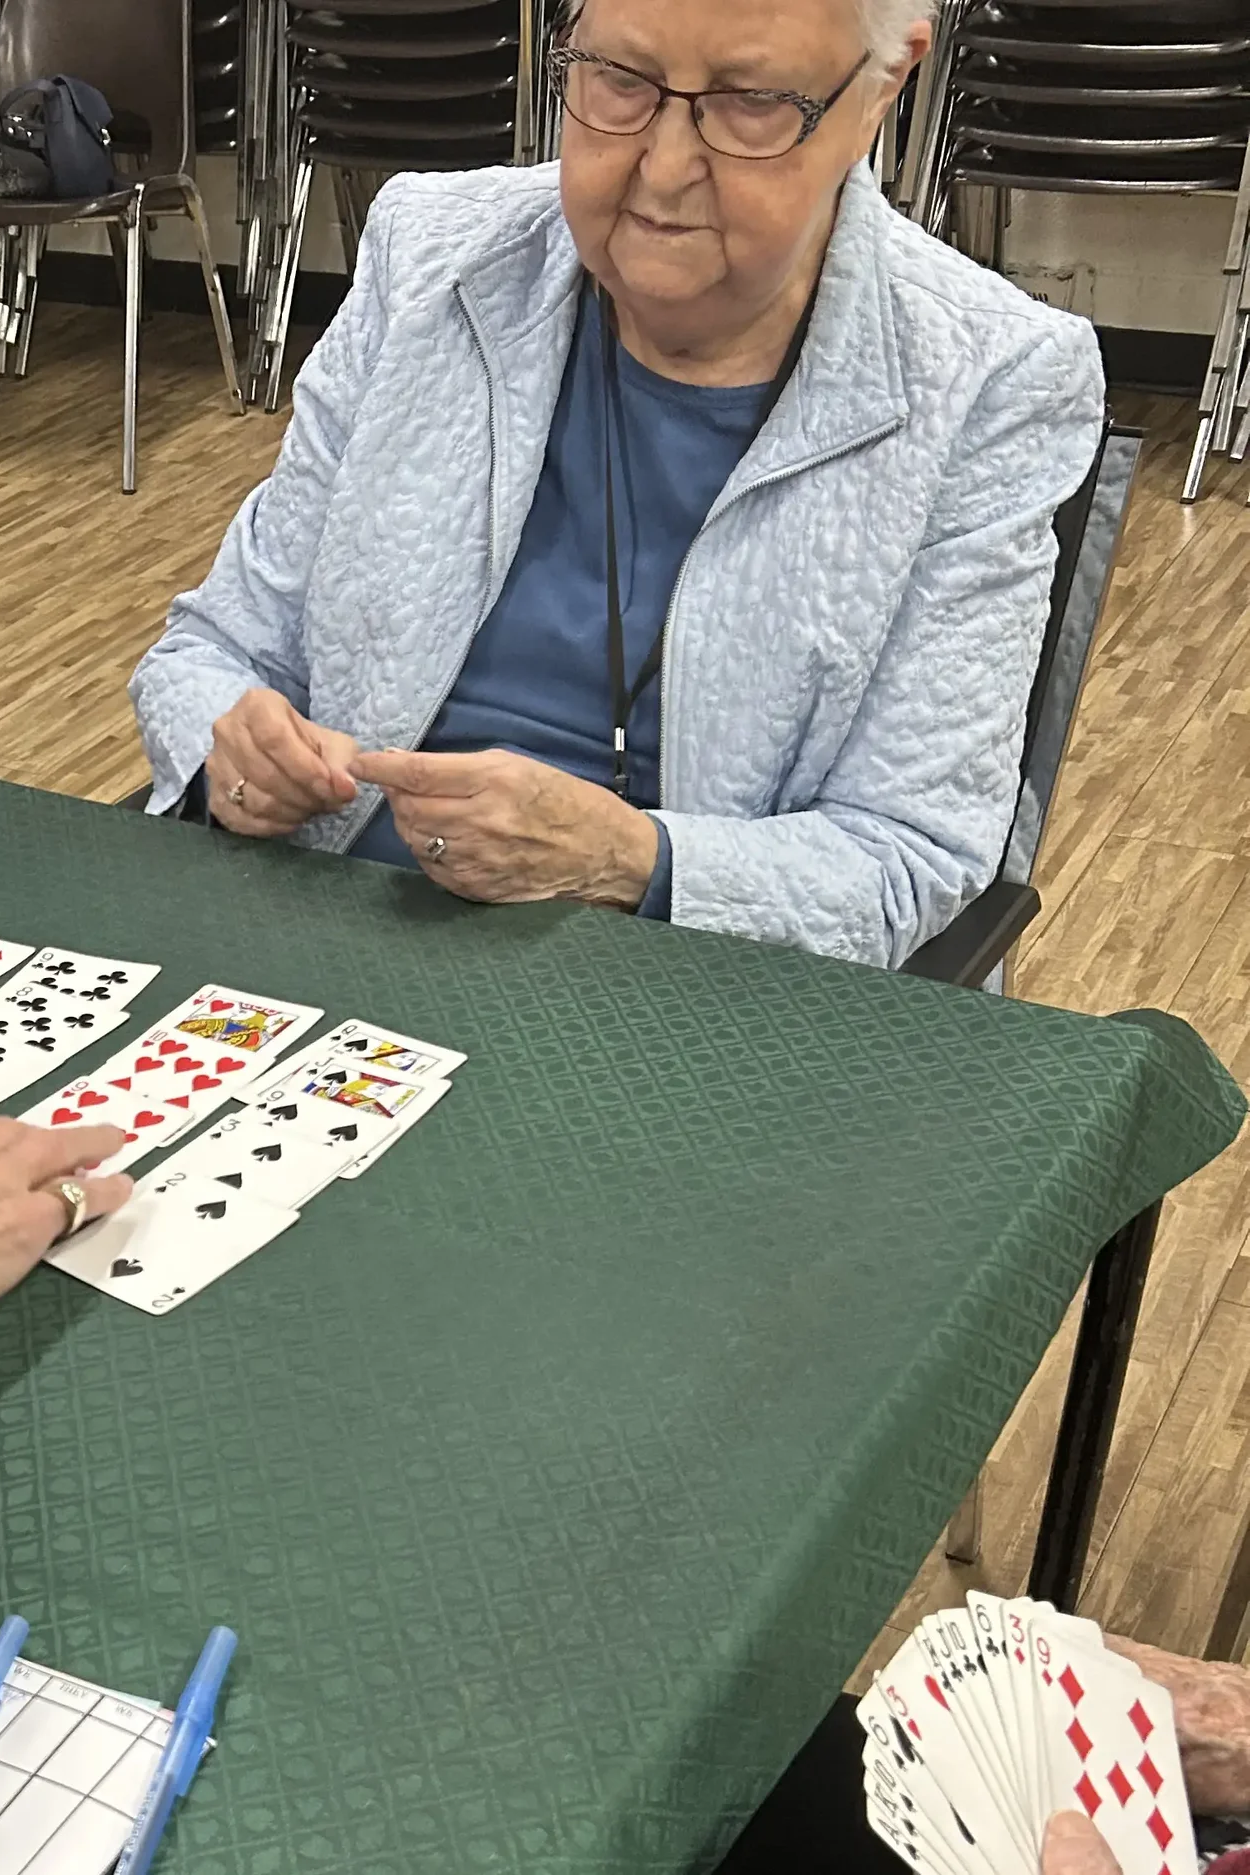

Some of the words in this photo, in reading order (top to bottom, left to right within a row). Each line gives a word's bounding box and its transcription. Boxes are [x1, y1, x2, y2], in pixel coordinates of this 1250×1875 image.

[16, 986, 33, 996] 8
[200, 990, 218, 1000] J
[149, 1030, 169, 1042] 10
[342, 1024, 358, 1035] Q
[314, 1057, 335, 1067] J
[266, 1090, 285, 1102] 9
[220, 1118, 241, 1132] 3
[165, 1172, 187, 1187] 2
[151, 1293, 175, 1309] 2
[976, 1604, 992, 1632] 6
[945, 1621, 967, 1650] 10
[1009, 1613, 1025, 1643] 3
[936, 1627, 952, 1658] J
[1036, 1637, 1051, 1665] 9
[59, 1682, 88, 1699] THEY
[886, 1685, 908, 1717] 3
[868, 1715, 890, 1746] 6
[877, 1818, 900, 1845] A
